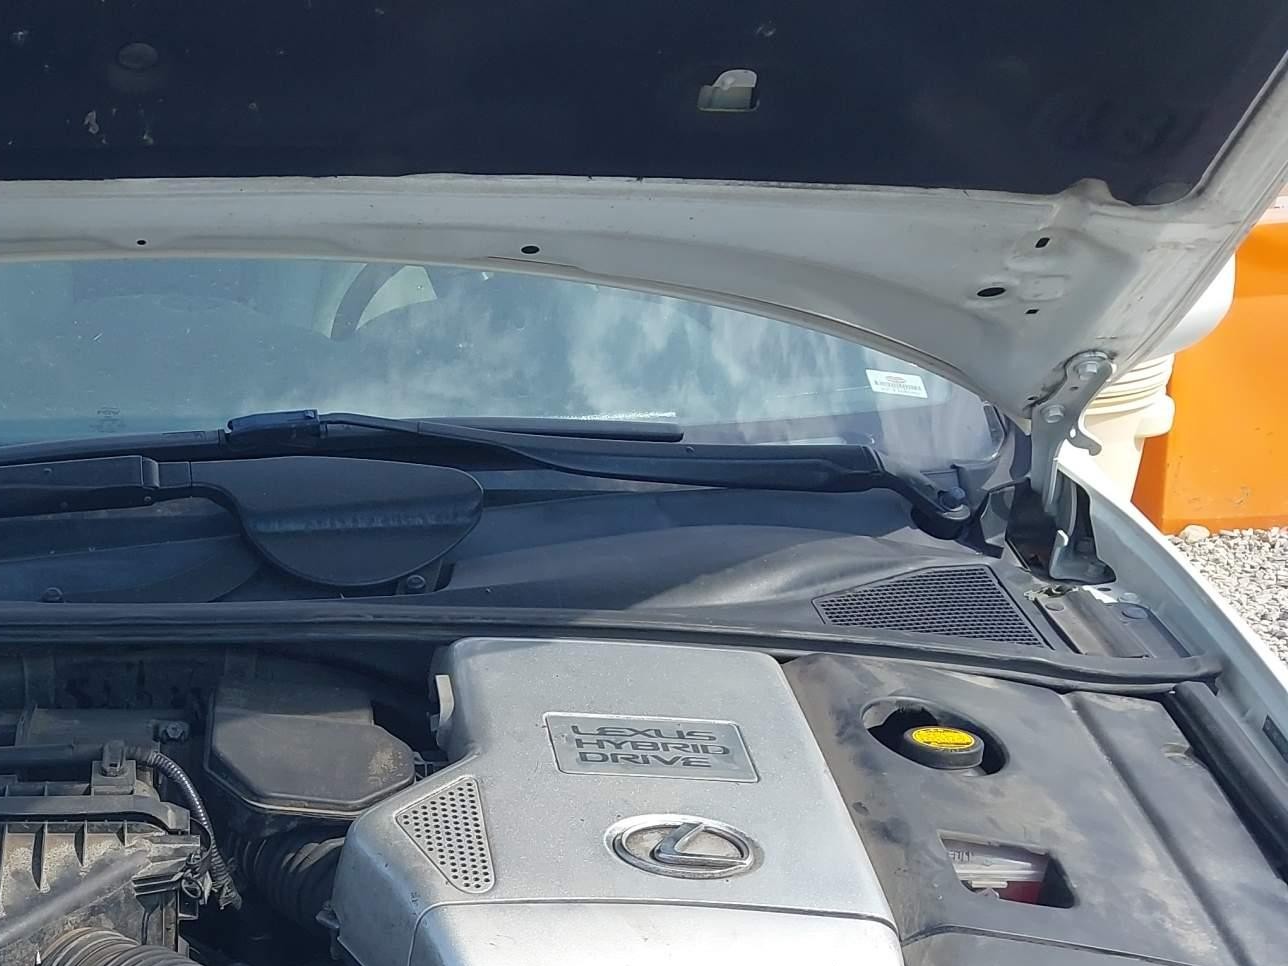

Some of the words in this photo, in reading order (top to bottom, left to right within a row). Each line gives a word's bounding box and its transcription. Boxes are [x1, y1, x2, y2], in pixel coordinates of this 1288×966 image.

[571, 724, 717, 741] LEXUS
[575, 738, 731, 755] HYBRID
[578, 751, 712, 768] DRIVE
